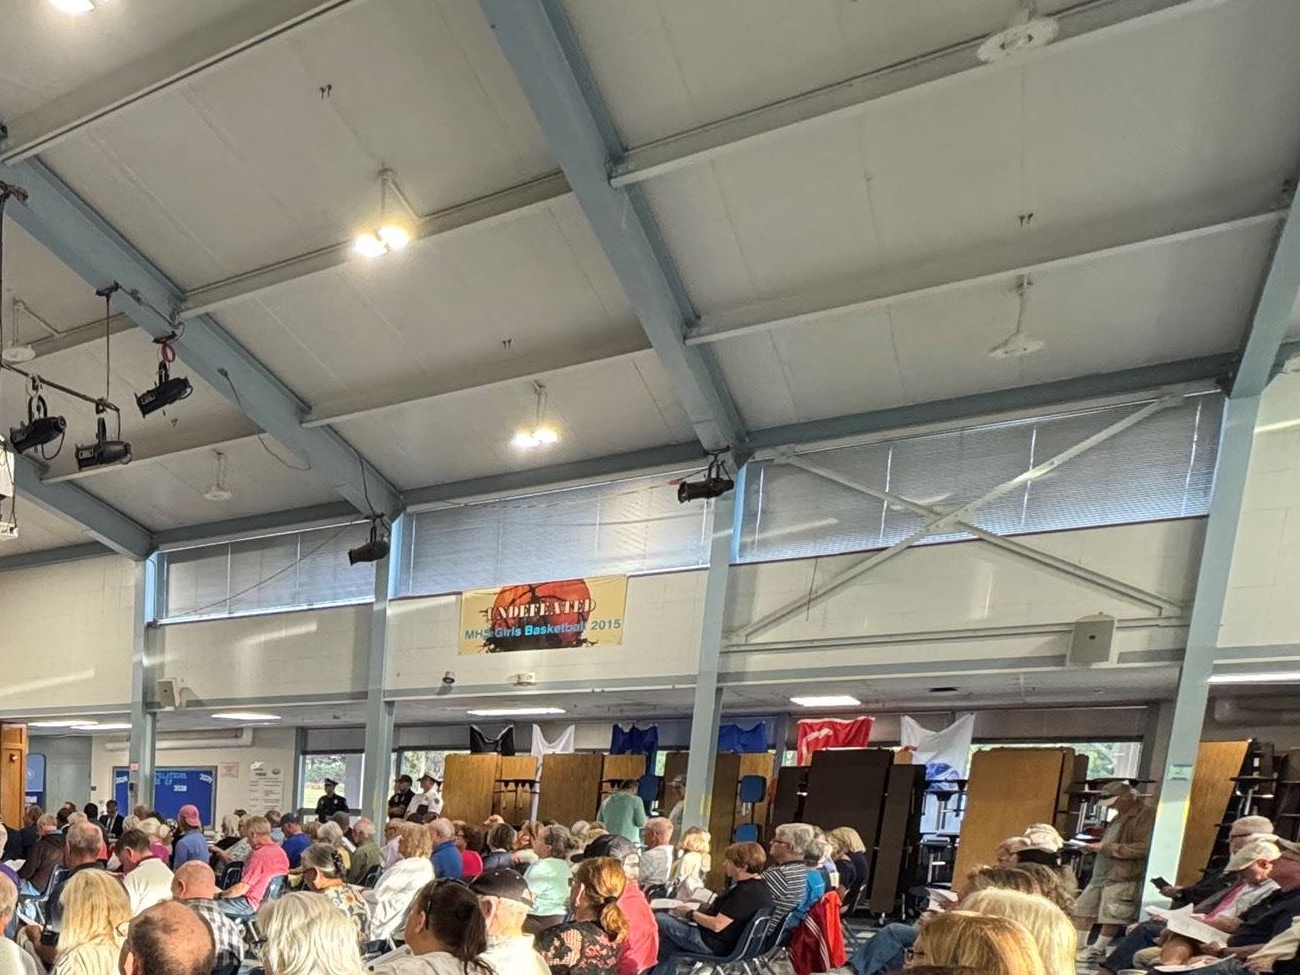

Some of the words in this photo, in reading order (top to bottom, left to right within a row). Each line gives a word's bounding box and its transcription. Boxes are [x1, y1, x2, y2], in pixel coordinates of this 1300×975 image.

[486, 599, 596, 619] UNDEFEATED
[465, 629, 491, 640] MHS
[495, 627, 521, 638] Girls
[524, 621, 586, 636] Basketball
[591, 620, 620, 631] 2015
